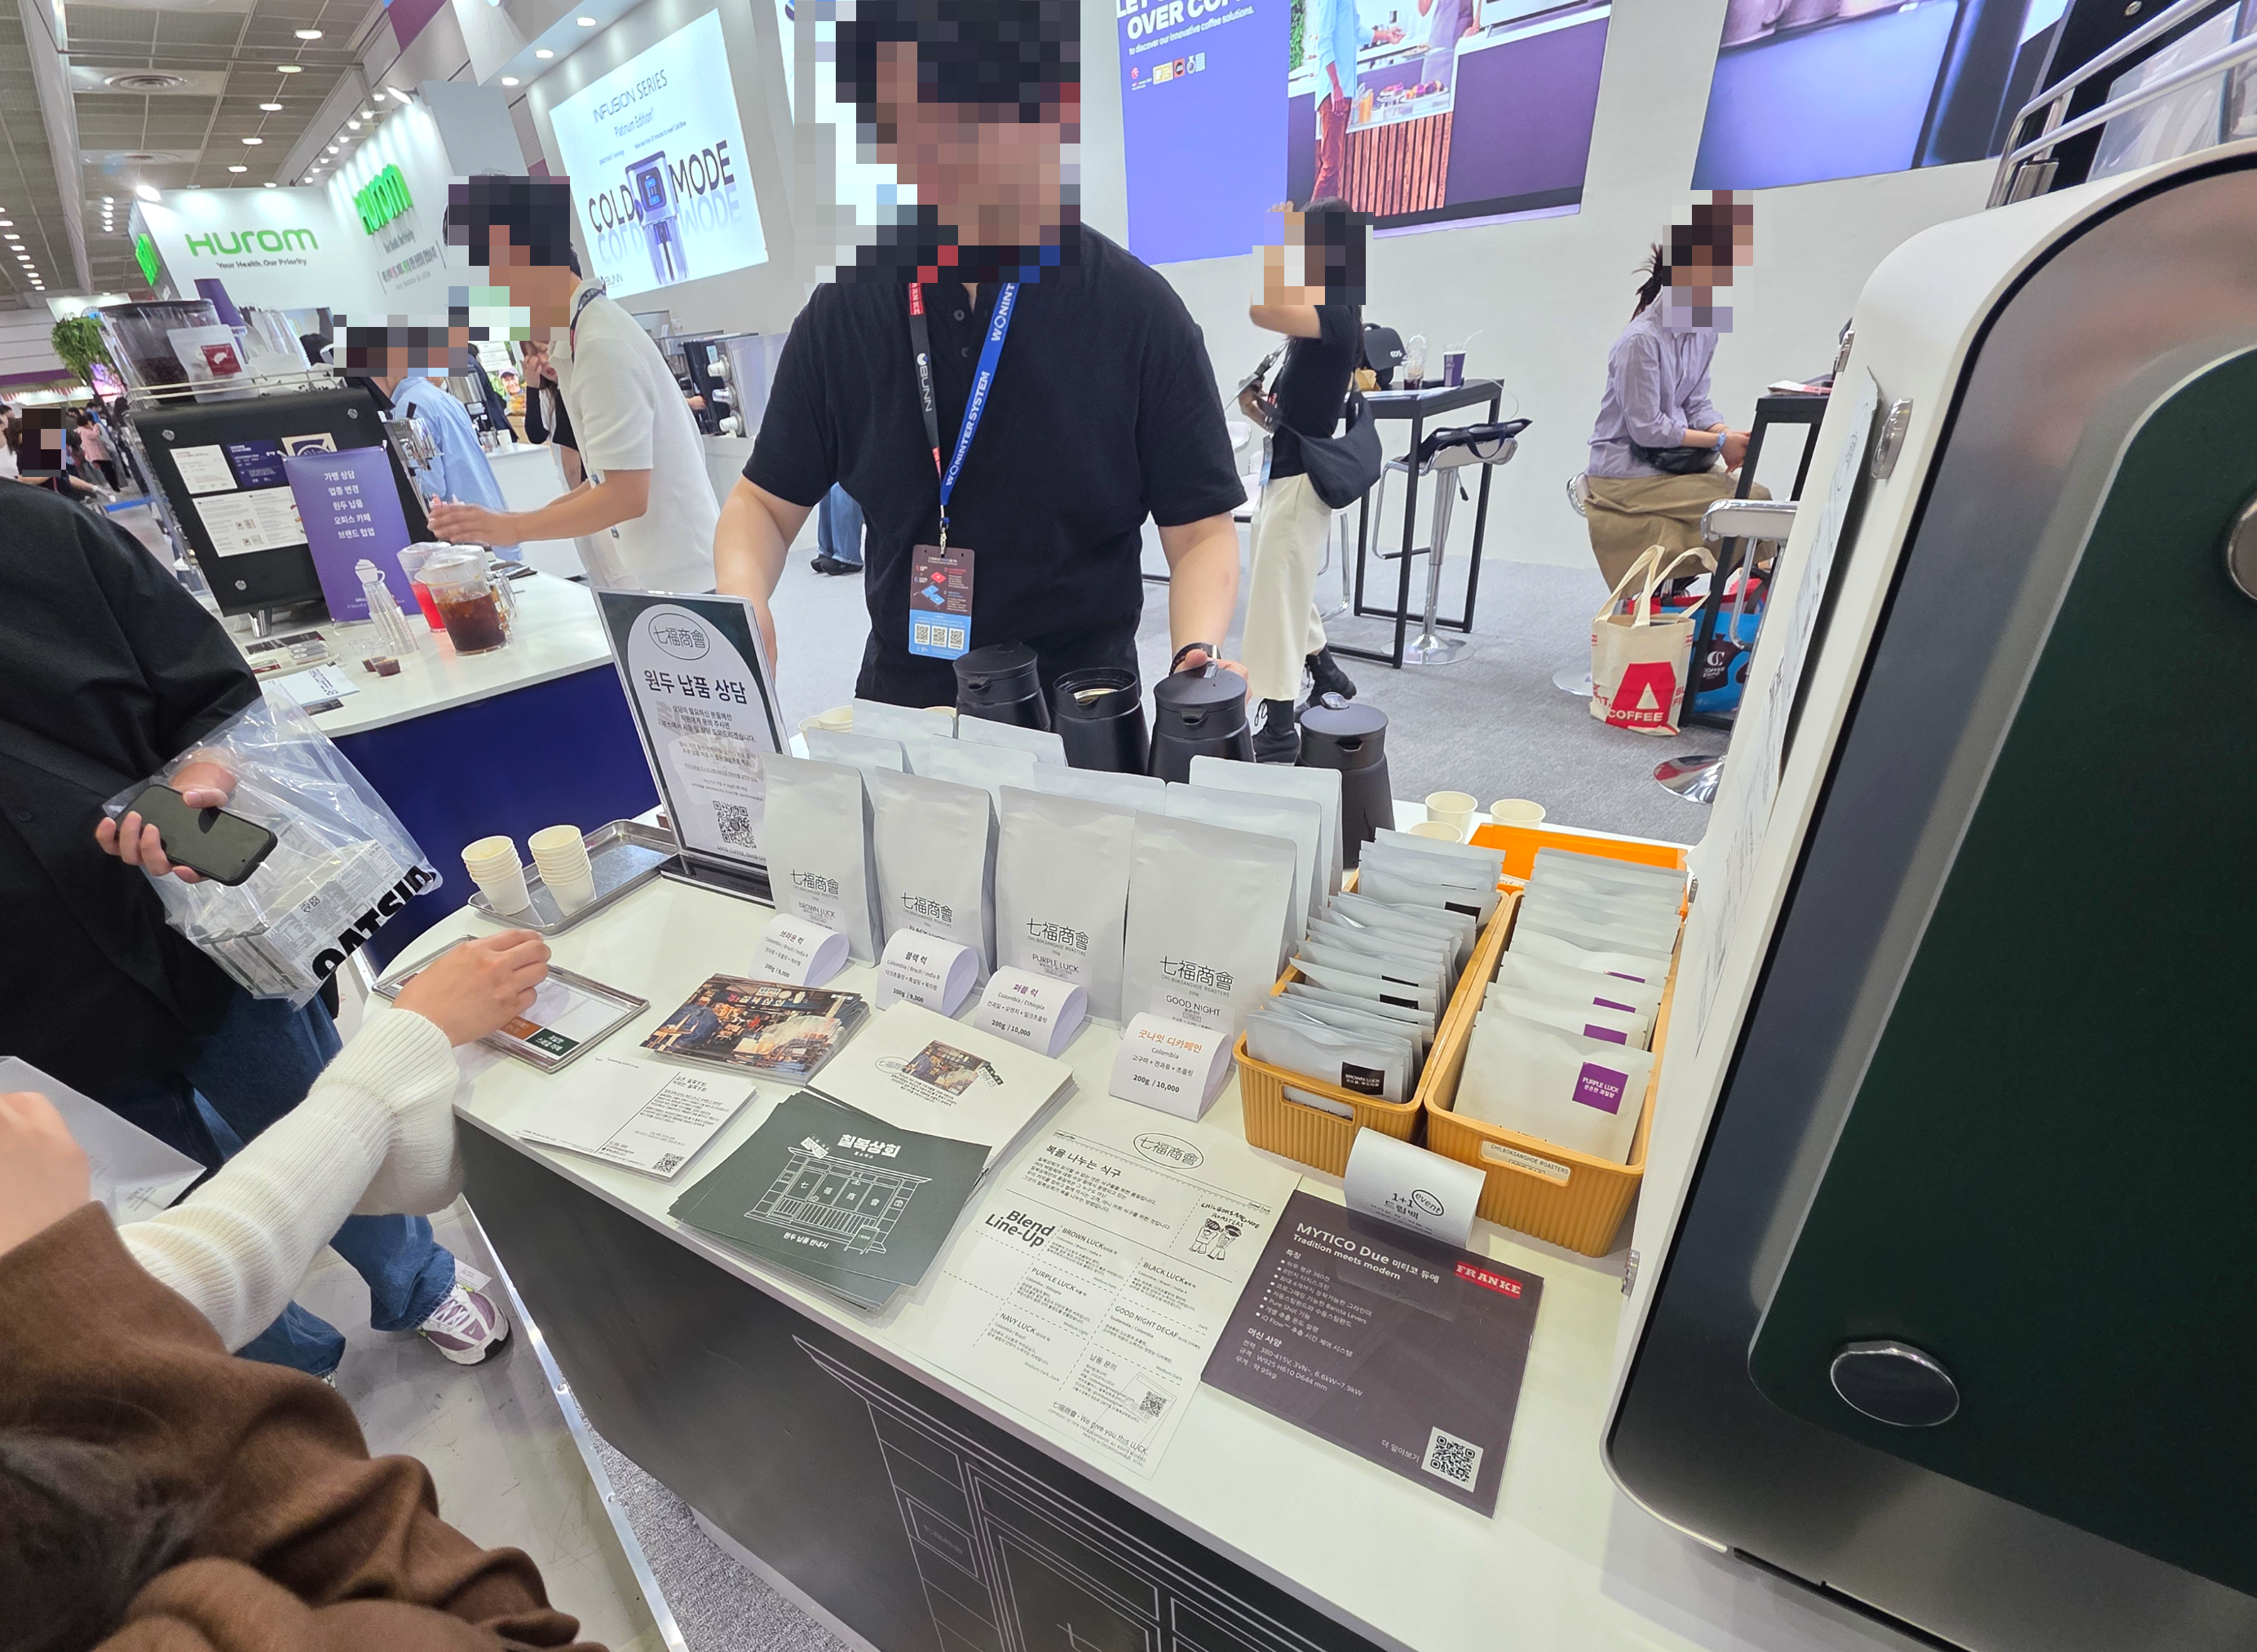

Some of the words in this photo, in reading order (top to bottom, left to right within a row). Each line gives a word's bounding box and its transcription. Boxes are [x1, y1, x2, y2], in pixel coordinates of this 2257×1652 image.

[1127, 1, 1184, 39] OVER
[1135, 39, 1159, 54] discover
[1159, 35, 1168, 45] our
[1169, 24, 1200, 42] innovative
[1201, 17, 1221, 32] coffee
[1222, 6, 1254, 24] solutions.
[593, 88, 636, 124] INFUSION
[637, 69, 667, 99] SERIES
[589, 185, 638, 233] COLD
[669, 139, 735, 204] MODE
[217, 262, 234, 270] Your
[236, 260, 263, 268] Health,
[279, 258, 307, 267] Priority
[920, 365, 932, 412] BUNN
[324, 472, 338, 481] 가맹
[340, 470, 356, 480] 상담
[329, 487, 343, 497] 업종
[345, 484, 360, 495] 변경
[333, 501, 347, 511] 원두
[348, 499, 364, 509] 납품
[333, 515, 356, 525] 오피스
[356, 513, 371, 523] 카페
[338, 528, 359, 539] 브랜드
[360, 528, 375, 537] 협업
[653, 626, 706, 648] 七福商會
[643, 669, 675, 694] 원두
[679, 672, 710, 699] 납품
[716, 679, 748, 705] 상담
[1608, 710, 1663, 722] COFFEE
[790, 869, 839, 894] 七福商會
[798, 902, 819, 913] BROWN
[820, 908, 836, 918] LUCK
[901, 892, 953, 923] 七福商會
[766, 937, 781, 946] Colombia
[784, 943, 793, 951] Brazil
[780, 931, 797, 942] 브라운
[1027, 918, 1089, 950] 七福商會
[887, 959, 907, 970] Colombia
[905, 952, 920, 962] 블랙
[920, 956, 928, 965] 럭
[1032, 954, 1058, 966] PURPLE
[1060, 962, 1079, 973] LUCK
[765, 963, 775, 972] 200g
[778, 970, 789, 978] 9,000
[1160, 956, 1234, 991] 七福商會
[893, 988, 905, 998] 200g
[910, 993, 924, 1002] 9,000
[998, 992, 1021, 1003] Colombia
[1024, 1000, 1045, 1010] Ethiopia
[1014, 984, 1028, 994] 퍼플
[1031, 988, 1039, 997] 럭
[1204, 987, 1230, 997] ROASTERS
[1005, 1006, 1019, 1014] 오렌지
[1166, 995, 1191, 1008] GOOD
[1194, 1003, 1221, 1016] NIGHT
[992, 1020, 1006, 1030] 200g
[1012, 1026, 1031, 1036] 10,000
[1138, 1030, 1164, 1044] 굿나잇
[1167, 1037, 1203, 1053] 디카페인
[1151, 1048, 1179, 1059] Colombia
[1133, 1054, 1148, 1064] 고구마
[1155, 1061, 1170, 1070] 견과류
[1176, 1067, 1194, 1077] 초콜릿
[1133, 1075, 1150, 1085] 200g
[1156, 1081, 1180, 1093] 10,000
[1583, 1077, 1604, 1088] PURPLE
[1605, 1084, 1619, 1093] LUCK
[837, 1135, 901, 1158] 칠복상회
[1139, 1137, 1199, 1166] 七福商會
[1045, 1144, 1067, 1159] 복을
[1065, 1151, 1098, 1171] 나누는
[1098, 1164, 1122, 1180] 식구
[1491, 1144, 1538, 1164] CHILBOKSANGHOE
[1539, 1160, 1569, 1174] ROASTERS
[1385, 1200, 1420, 1220] 드립백
[1391, 1193, 1414, 1208] 1+1
[1416, 1192, 1441, 1213] event
[1006, 1211, 1056, 1236] Blend
[1200, 1203, 1261, 1230] CHILBOKSANGHOE
[1212, 1213, 1243, 1228] ROASTERS
[782, 1232, 797, 1240] 원두
[795, 1236, 810, 1244] 납품
[808, 1239, 829, 1249] 안내서
[985, 1214, 1045, 1248] Line-Up
[1061, 1227, 1087, 1242] BROWN
[1085, 1238, 1105, 1249] LUCK
[1284, 1249, 1301, 1260] 특징
[1292, 1235, 1332, 1254] Tradition
[1333, 1250, 1363, 1266] meets
[1363, 1261, 1402, 1280] modern
[1296, 1222, 1357, 1252] MYTICO
[1358, 1246, 1391, 1265] Due
[1390, 1260, 1420, 1275] 미티코
[1419, 1270, 1440, 1283] 듀에
[1031, 1267, 1058, 1283] PURPLE
[1057, 1279, 1075, 1292] LUCK
[1142, 1262, 1166, 1276] BLACK
[1165, 1271, 1186, 1284] LUCK
[1282, 1269, 1299, 1278] 8인치
[1299, 1275, 1330, 1291] 터치스크린
[1285, 1261, 1299, 1270] 하루
[1299, 1266, 1312, 1274] 평균
[1311, 1272, 1331, 1282] 360잔
[1456, 1264, 1522, 1295] FRANKE
[1274, 1283, 1305, 1299] 프로그래밍
[1325, 1304, 1347, 1315] Barista
[1347, 1313, 1367, 1324] Levers
[1279, 1276, 1292, 1284] 최대
[1292, 1281, 1314, 1293] 4개까지
[1346, 1303, 1372, 1317] 그라인더
[1264, 1307, 1278, 1315] 개별
[1277, 1312, 1292, 1321] 추출
[1292, 1318, 1305, 1327] 온도
[1305, 1323, 1319, 1332] 설정
[1267, 1299, 1283, 1308] Pure
[1282, 1305, 1297, 1314] Shot
[1297, 1311, 1311, 1320] 기능
[1000, 1313, 1018, 1325] NAVY
[1017, 1321, 1036, 1334] LUCK
[1114, 1305, 1134, 1319] GOOD
[1133, 1314, 1156, 1329] NIGHT
[1155, 1324, 1178, 1339] DECAF
[1246, 1327, 1265, 1340] 머신
[1263, 1335, 1283, 1348] 사양
[1290, 1327, 1304, 1336] 추출
[1303, 1332, 1318, 1342] 시간
[1318, 1339, 1332, 1348] 제어
[1332, 1345, 1354, 1358] 시스템
[1089, 1354, 1103, 1365] 납품
[1102, 1360, 1117, 1372] 문의
[1241, 1340, 1257, 1349] 전력
[1258, 1347, 1293, 1366] 380-415V,
[1234, 1356, 1249, 1366] 무게
[1259, 1367, 1278, 1379] 95kg
[1238, 1348, 1252, 1357] 규격
[1255, 1355, 1276, 1367] W925
[1275, 1365, 1295, 1376] H610
[1294, 1372, 1314, 1384] D644
[1313, 1382, 1328, 1391] mm
[1079, 1415, 1090, 1425] We
[1089, 1420, 1105, 1433] give
[1103, 1429, 1116, 1440] you
[1116, 1435, 1129, 1446] this
[1129, 1441, 1150, 1456] LUCK.
[1380, 1440, 1389, 1448] 더
[1389, 1443, 1420, 1462] 알아보기
